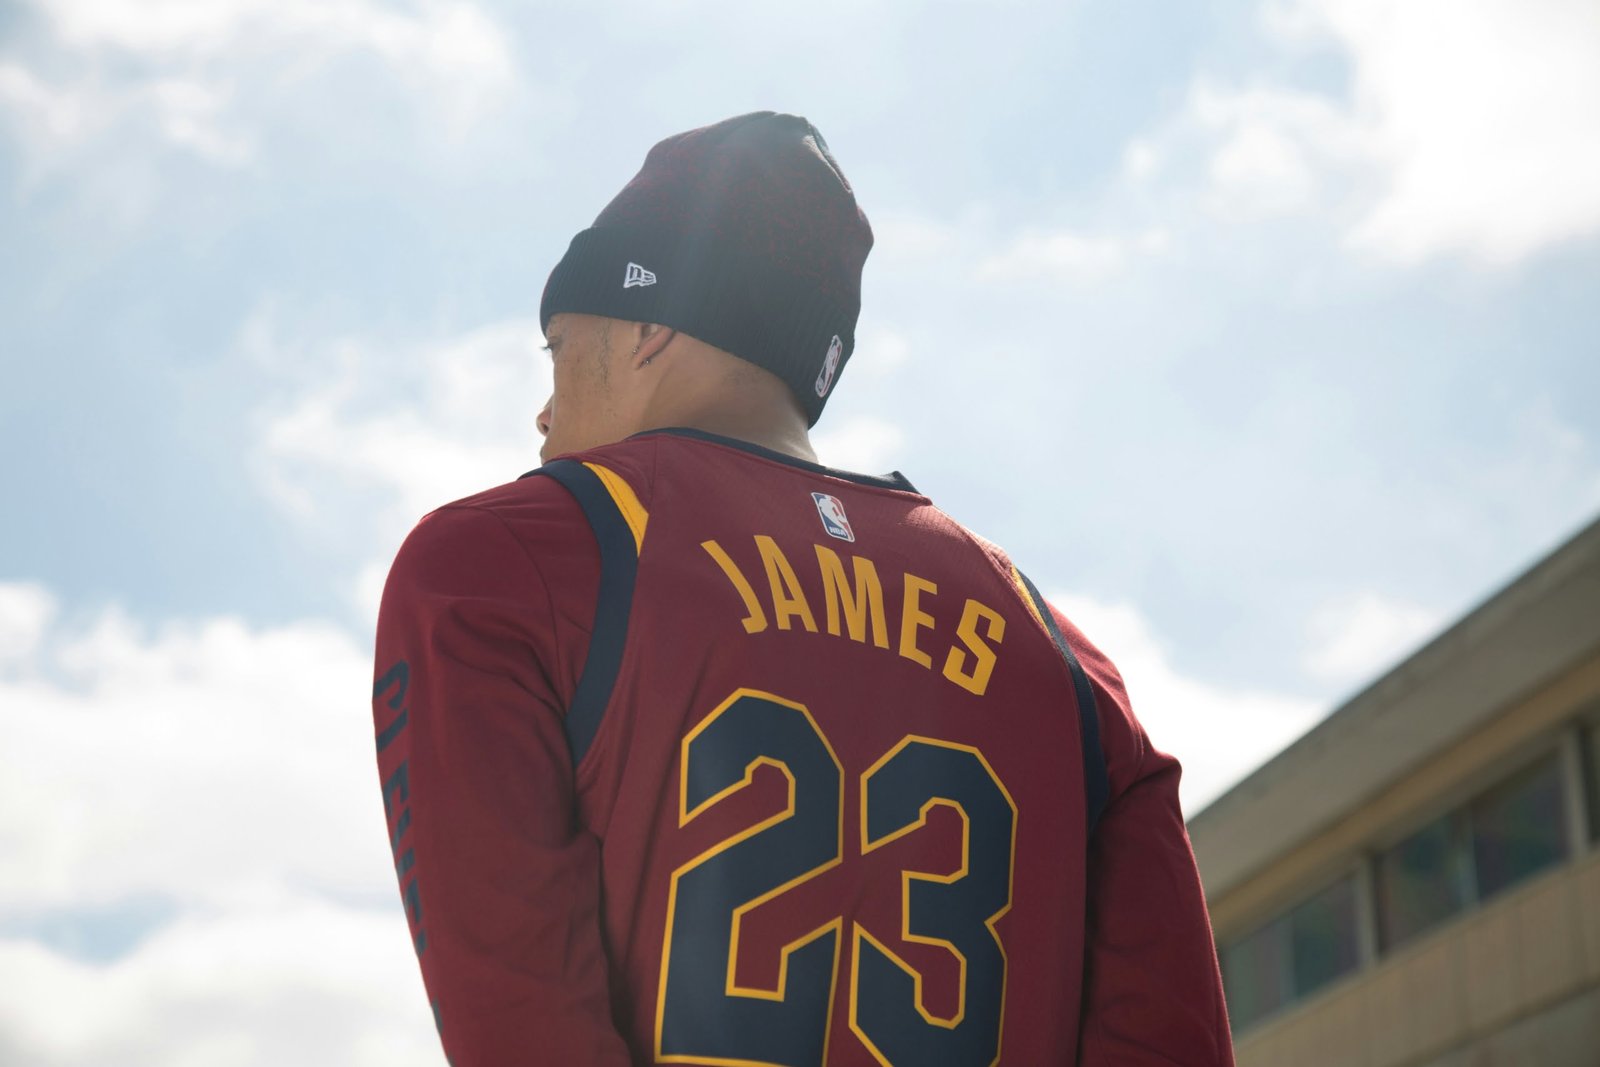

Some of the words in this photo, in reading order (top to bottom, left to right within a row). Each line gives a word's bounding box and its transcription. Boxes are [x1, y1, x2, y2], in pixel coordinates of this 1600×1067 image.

[829, 526, 847, 537] NBA
[700, 535, 1006, 696] JAMES
[654, 687, 1018, 1067] 23
